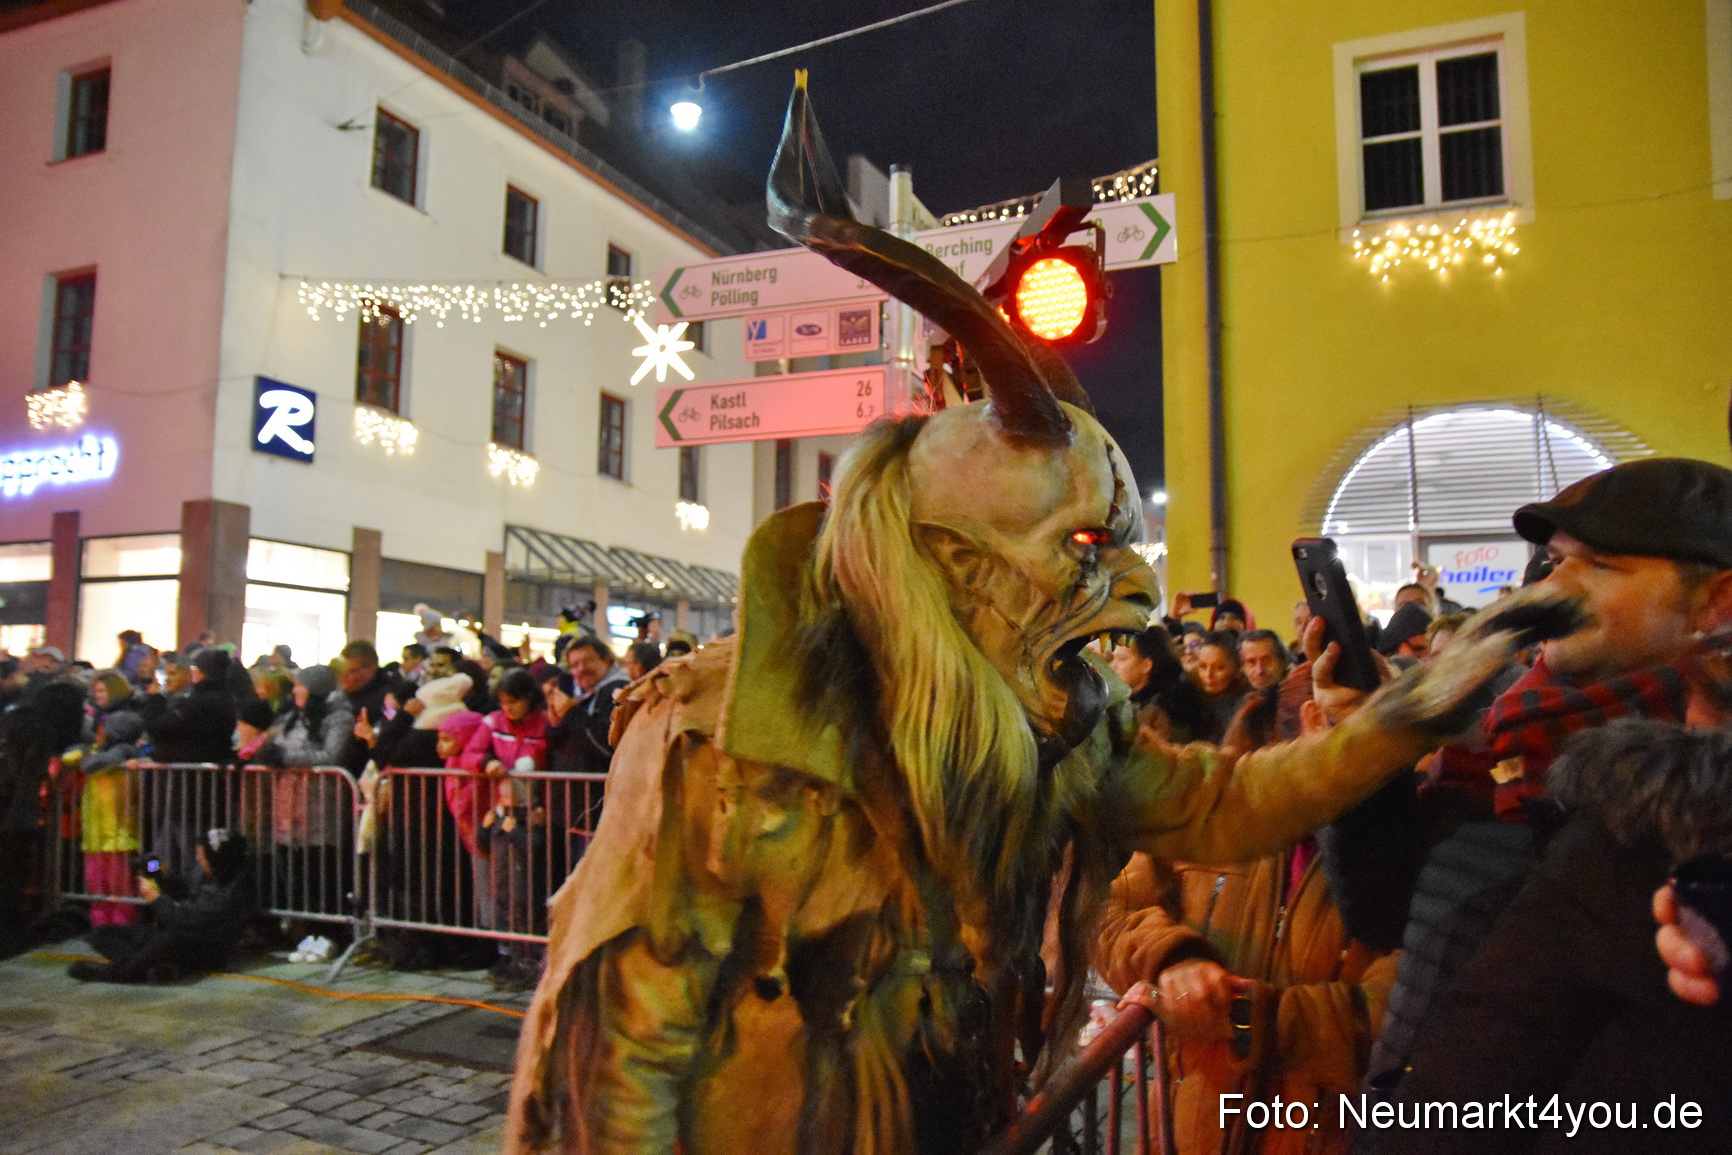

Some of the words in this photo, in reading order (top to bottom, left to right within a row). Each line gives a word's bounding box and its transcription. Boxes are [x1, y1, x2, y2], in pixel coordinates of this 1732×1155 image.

[711, 266, 778, 286] Nürnberg
[711, 288, 759, 307] Pölling
[856, 379, 872, 397] 26
[710, 391, 747, 410] Kastl
[257, 389, 316, 455] R
[709, 411, 761, 431] Pilsach
[1455, 545, 1500, 569] FOTO
